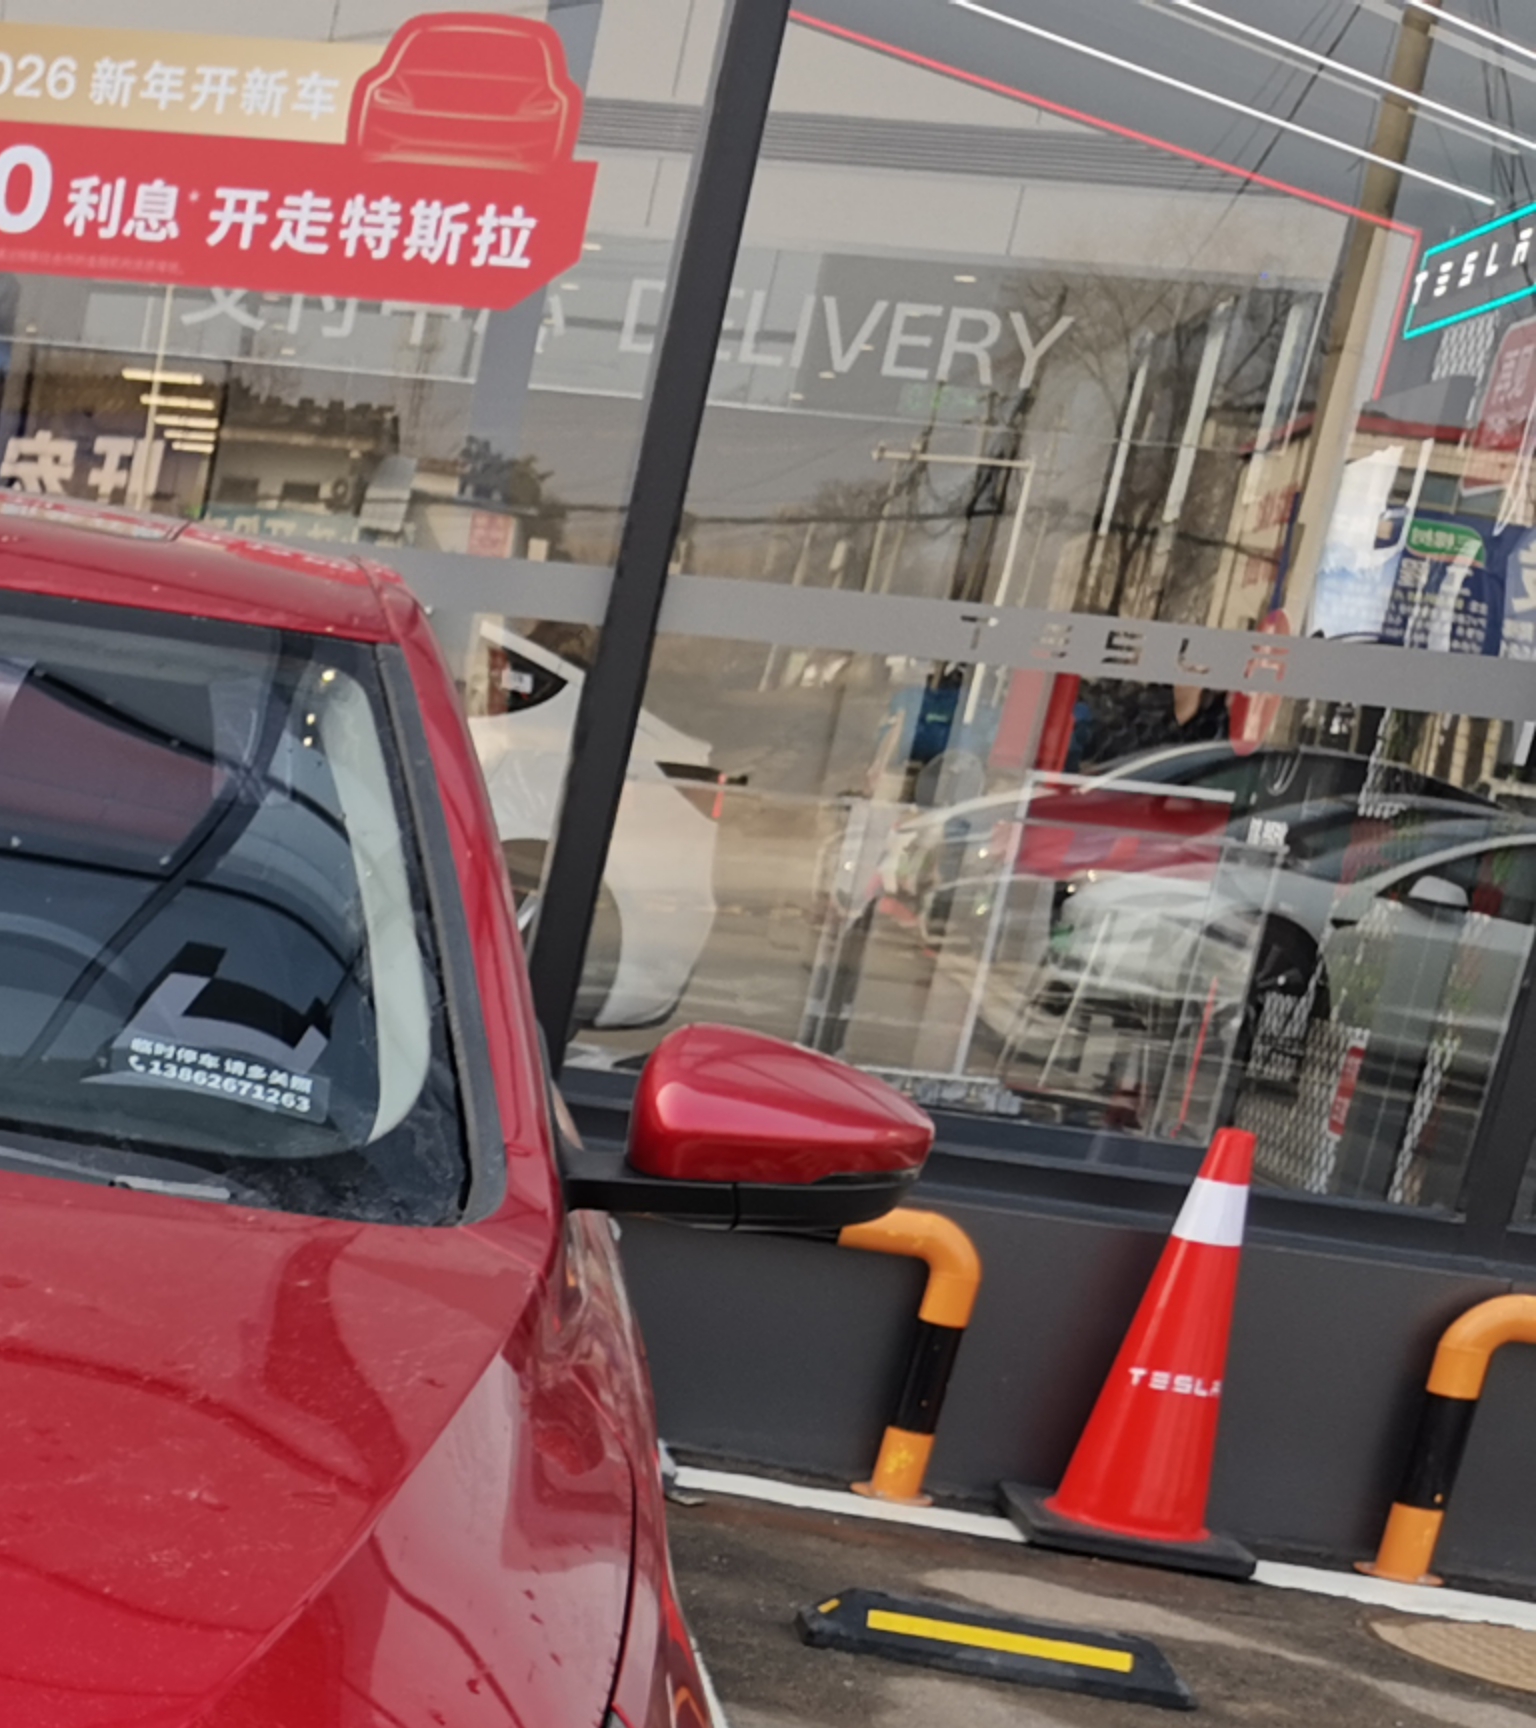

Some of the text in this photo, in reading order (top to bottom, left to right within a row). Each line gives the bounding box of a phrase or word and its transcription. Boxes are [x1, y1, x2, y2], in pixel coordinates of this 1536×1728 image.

[90, 56, 340, 121] 新年开新车
[206, 186, 537, 268] 开走特斯拉
[1412, 227, 1534, 305] TESLA
[961, 615, 1290, 681] TESLA
[149, 1059, 311, 1113] 13862671263
